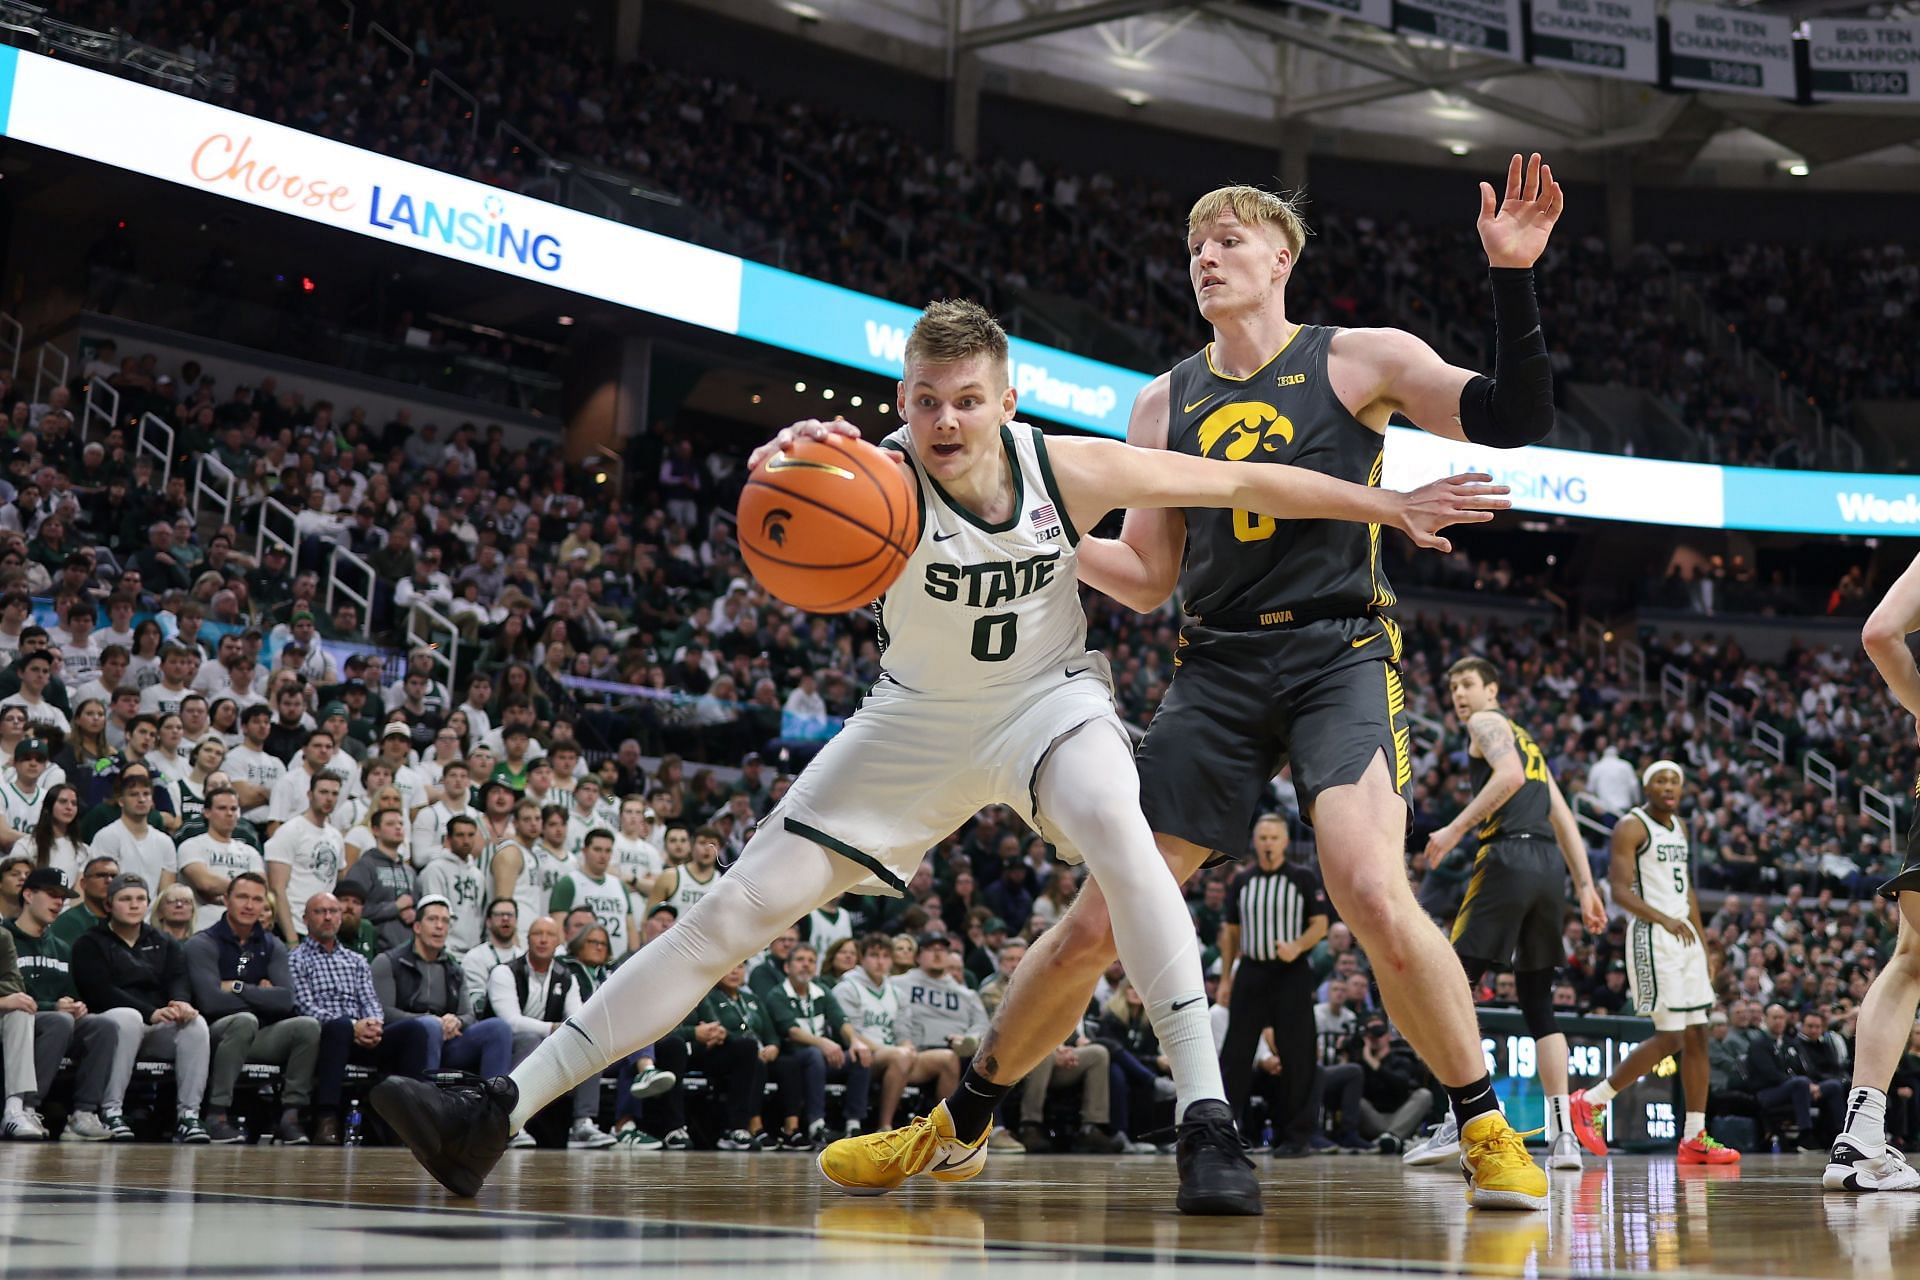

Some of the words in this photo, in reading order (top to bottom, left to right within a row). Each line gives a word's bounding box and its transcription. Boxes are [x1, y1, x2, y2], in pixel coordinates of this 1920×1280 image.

[1596, 2, 1631, 18] TEN
[1536, 12, 1652, 41] CHAMPIONS
[1695, 14, 1726, 32] BIG
[1732, 19, 1766, 36] TEN
[1836, 28, 1868, 43] BIG
[1876, 29, 1912, 43] TEN
[1676, 31, 1789, 60] CHAMPIONS
[1850, 72, 1904, 93] 1990
[190, 133, 355, 213] Choose
[924, 547, 1061, 608] STATE
[1259, 610, 1294, 626] IOWA
[970, 612, 1018, 662] 0
[1657, 844, 1688, 862] STATE
[1673, 867, 1684, 893] 5
[1507, 1036, 1537, 1078] 19
[1568, 1045, 1601, 1076] :43
